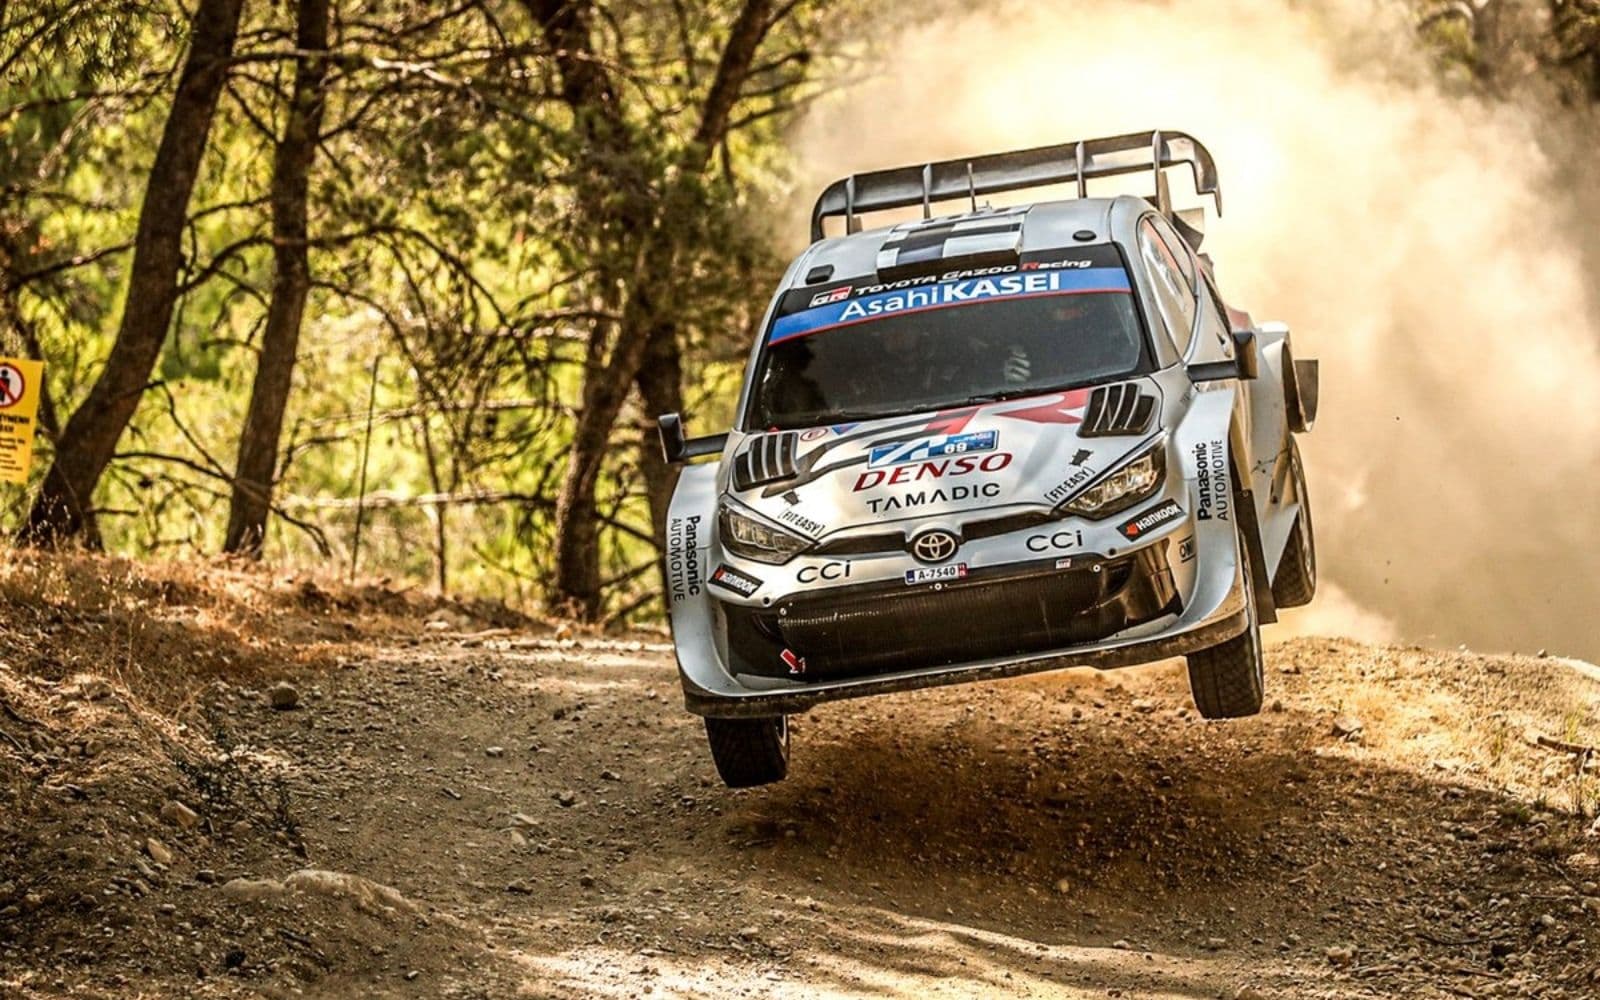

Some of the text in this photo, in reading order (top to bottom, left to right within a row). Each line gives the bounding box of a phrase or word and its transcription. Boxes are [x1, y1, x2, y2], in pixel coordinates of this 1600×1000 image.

[856, 275, 936, 295] TOYOTA
[942, 264, 1017, 280] GAZOO
[1022, 259, 1092, 271] Racing
[852, 452, 1013, 492] DENSO
[866, 483, 1001, 513] TAMADIC
[1192, 442, 1213, 521] Panasonic
[1211, 440, 1228, 520] AUTOMOTIVE
[670, 518, 685, 601] AUTOMOTIVE
[686, 515, 703, 596] Panasonic
[918, 567, 956, 579] A-7540
